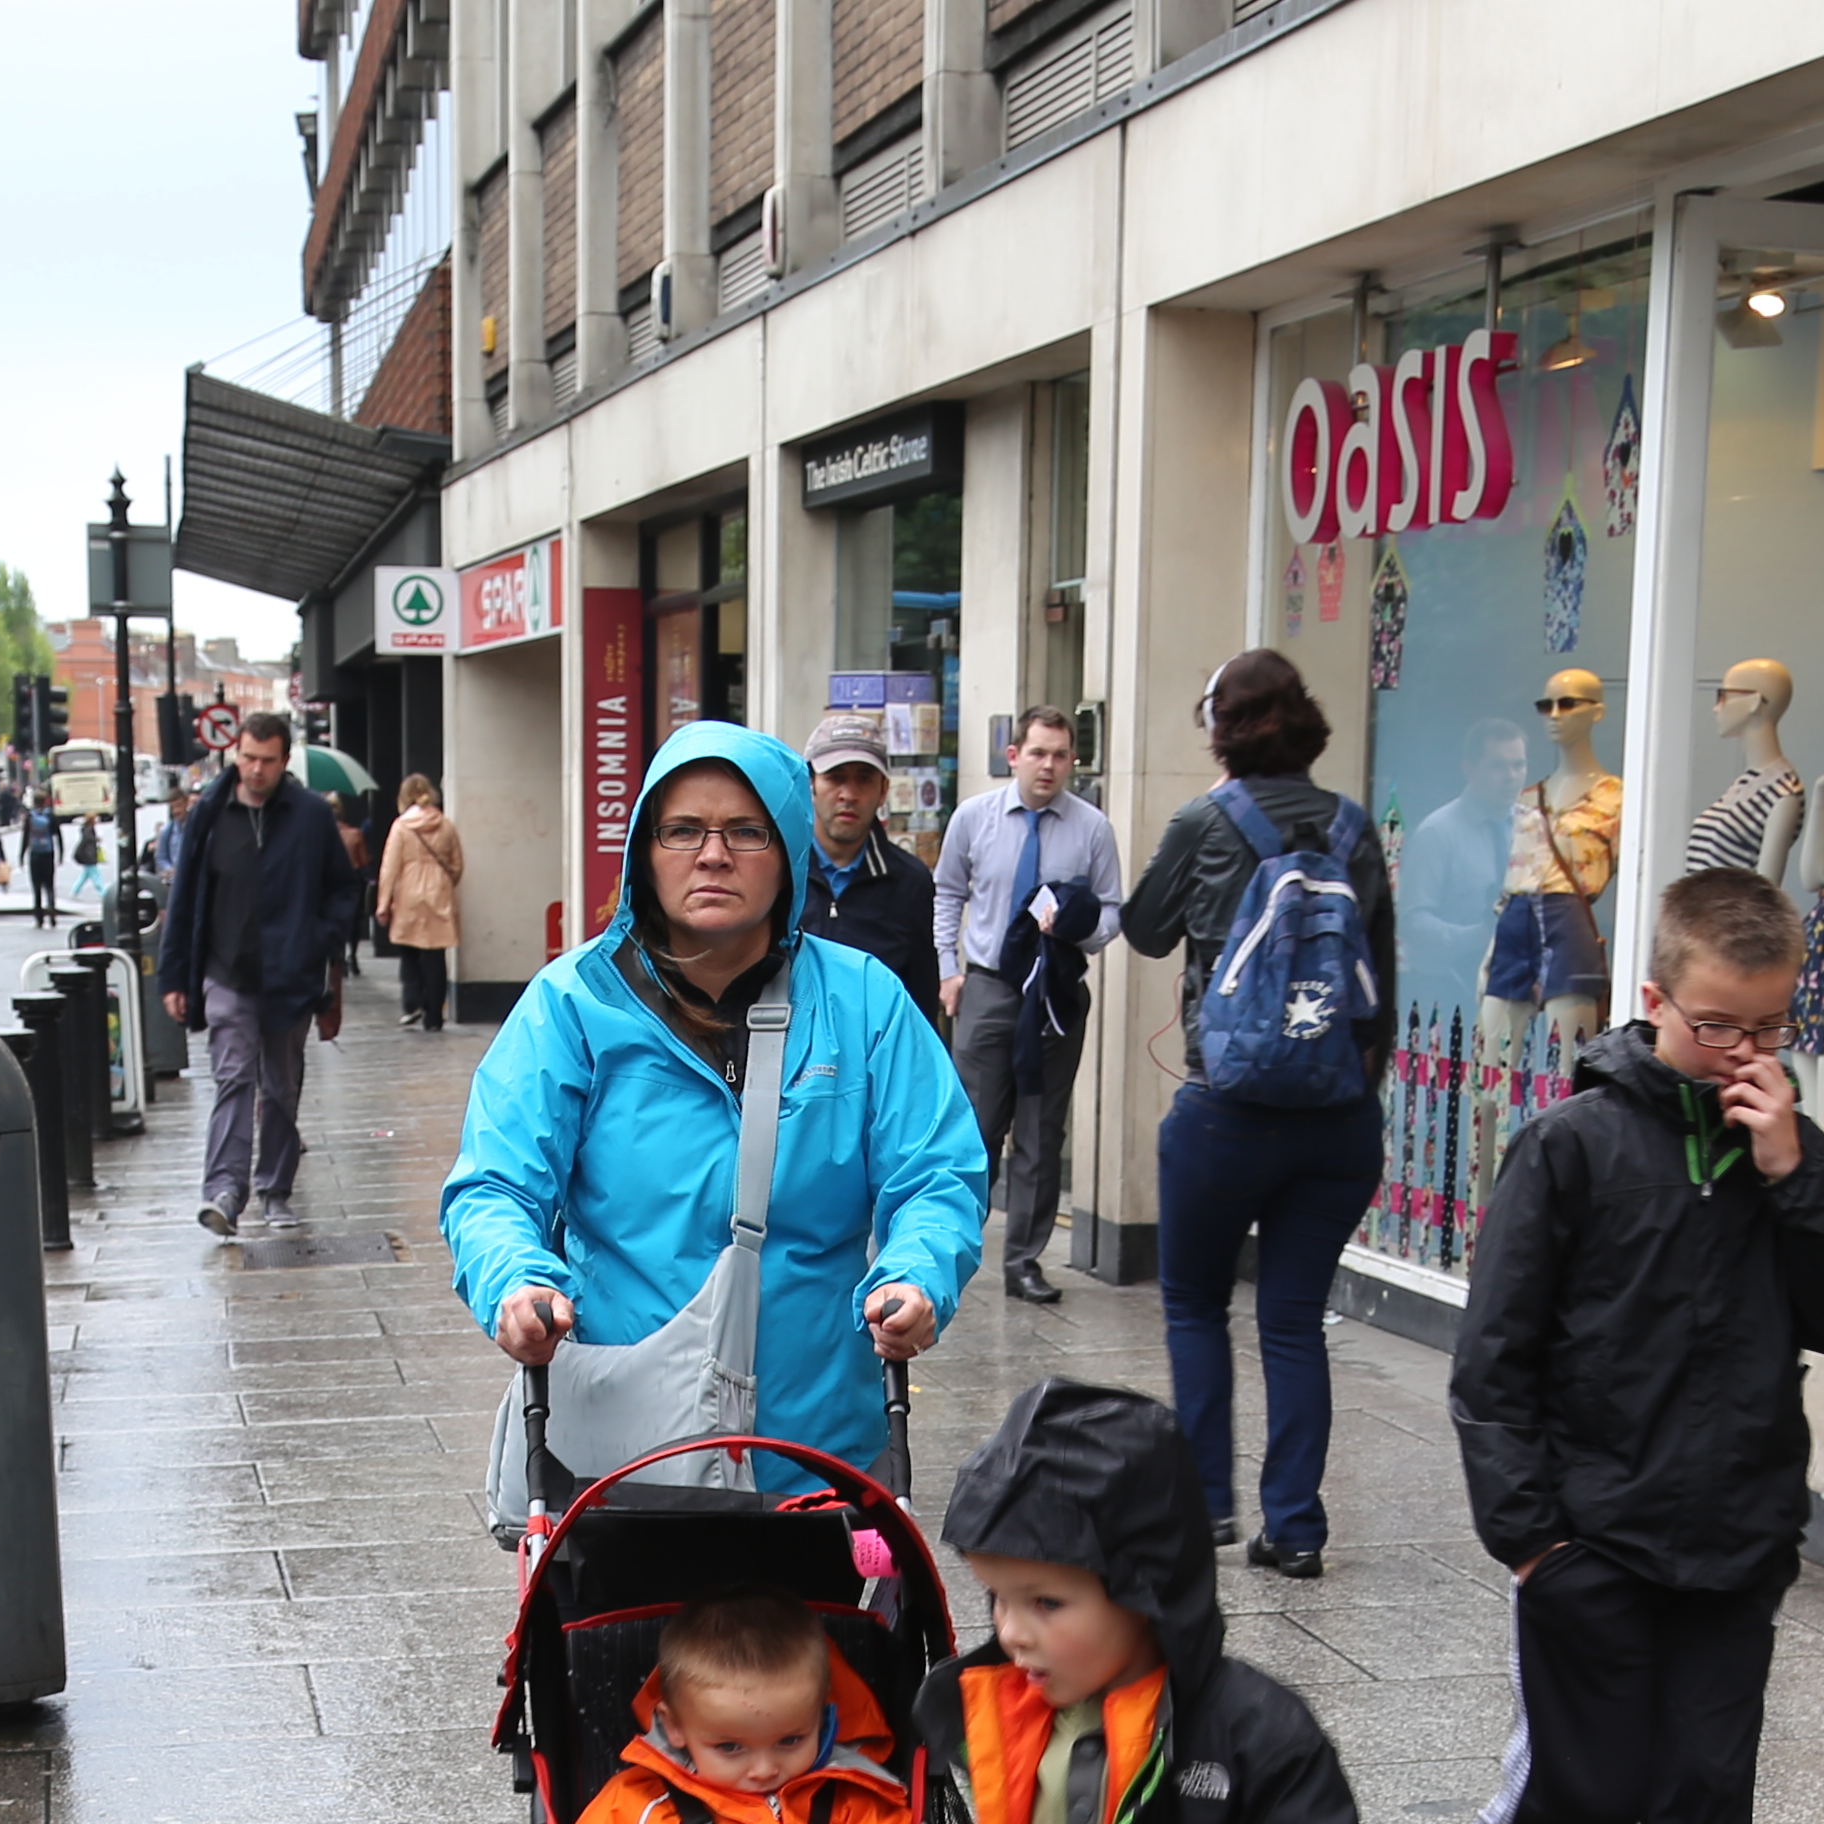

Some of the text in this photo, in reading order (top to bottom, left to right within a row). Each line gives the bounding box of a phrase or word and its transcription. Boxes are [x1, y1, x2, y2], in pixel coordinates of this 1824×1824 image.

[805, 434, 927, 492] The Irish Celtic Store
[481, 568, 525, 630] SPAR
[392, 634, 444, 647] SPAR
[596, 695, 627, 853] INSOMNIA
